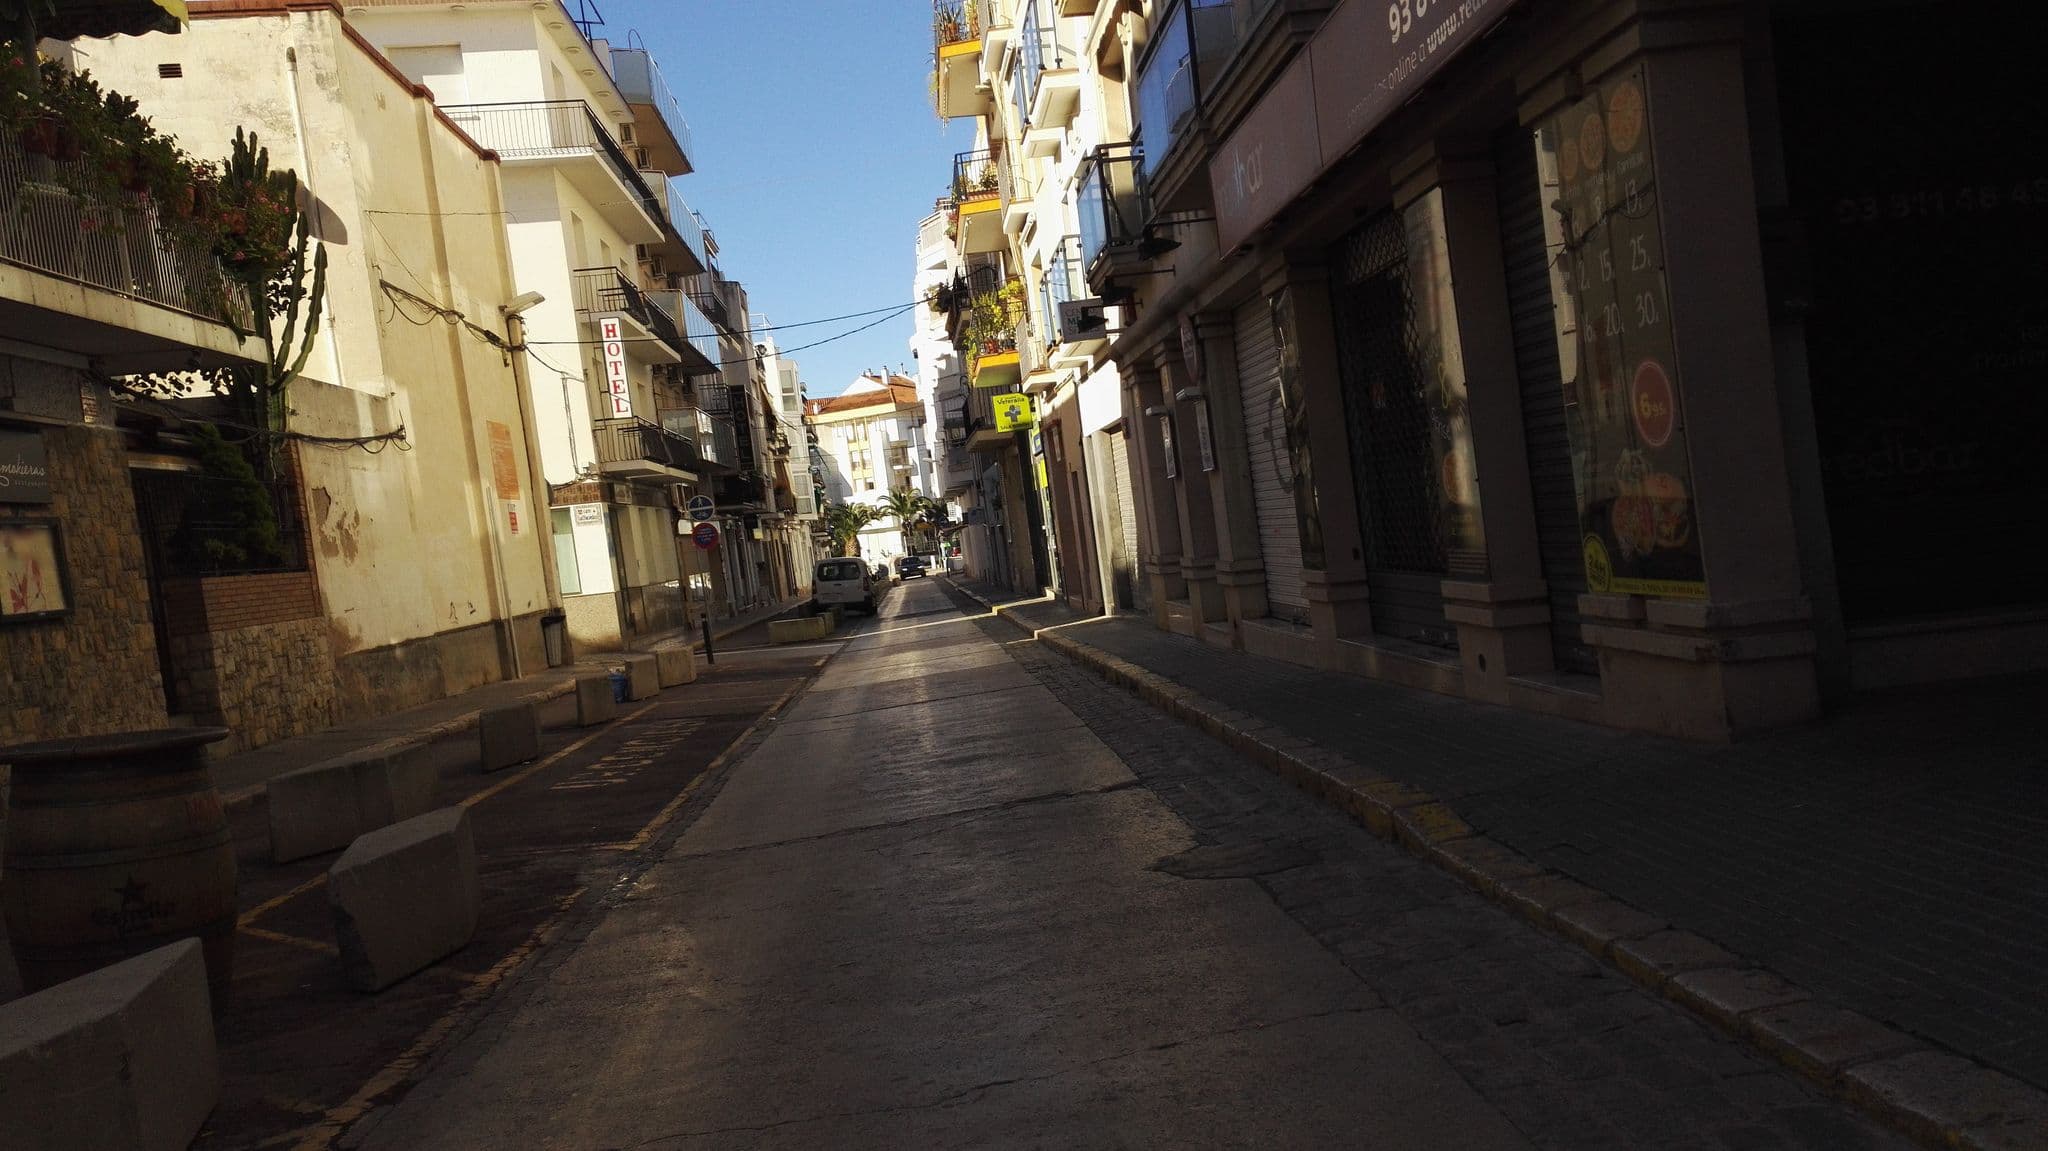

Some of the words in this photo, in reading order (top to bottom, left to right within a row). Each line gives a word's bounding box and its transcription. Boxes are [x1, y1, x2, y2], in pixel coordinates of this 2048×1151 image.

[1388, 50, 1417, 90] online
[1419, 43, 1427, 63] a
[604, 323, 628, 413] HOTEL
